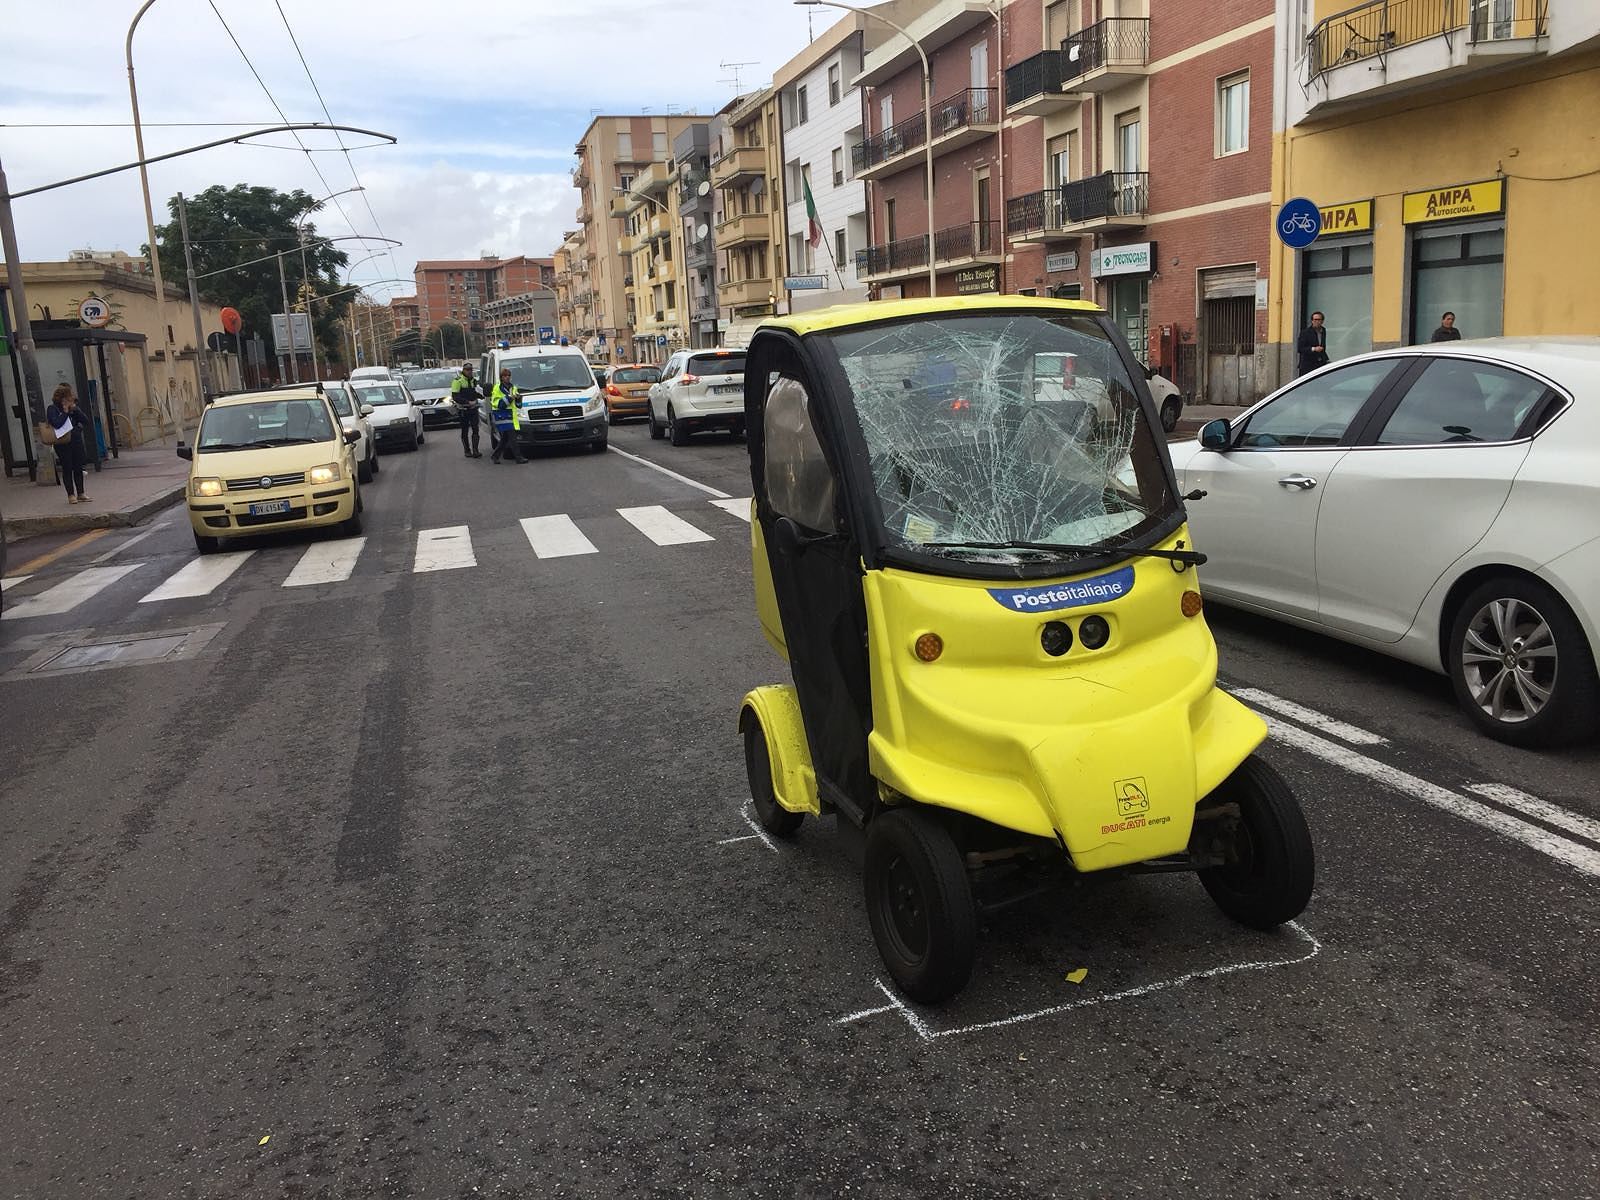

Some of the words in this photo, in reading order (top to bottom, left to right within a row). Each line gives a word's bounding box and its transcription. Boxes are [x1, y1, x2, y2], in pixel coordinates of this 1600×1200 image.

[1427, 188, 1472, 208] AMPA
[1320, 207, 1358, 231] MPA
[1113, 251, 1148, 265] TECNOCASA
[1012, 582, 1123, 609] Posteitaliane
[1101, 818, 1146, 834] DUCATI
[1148, 816, 1171, 826] energia
